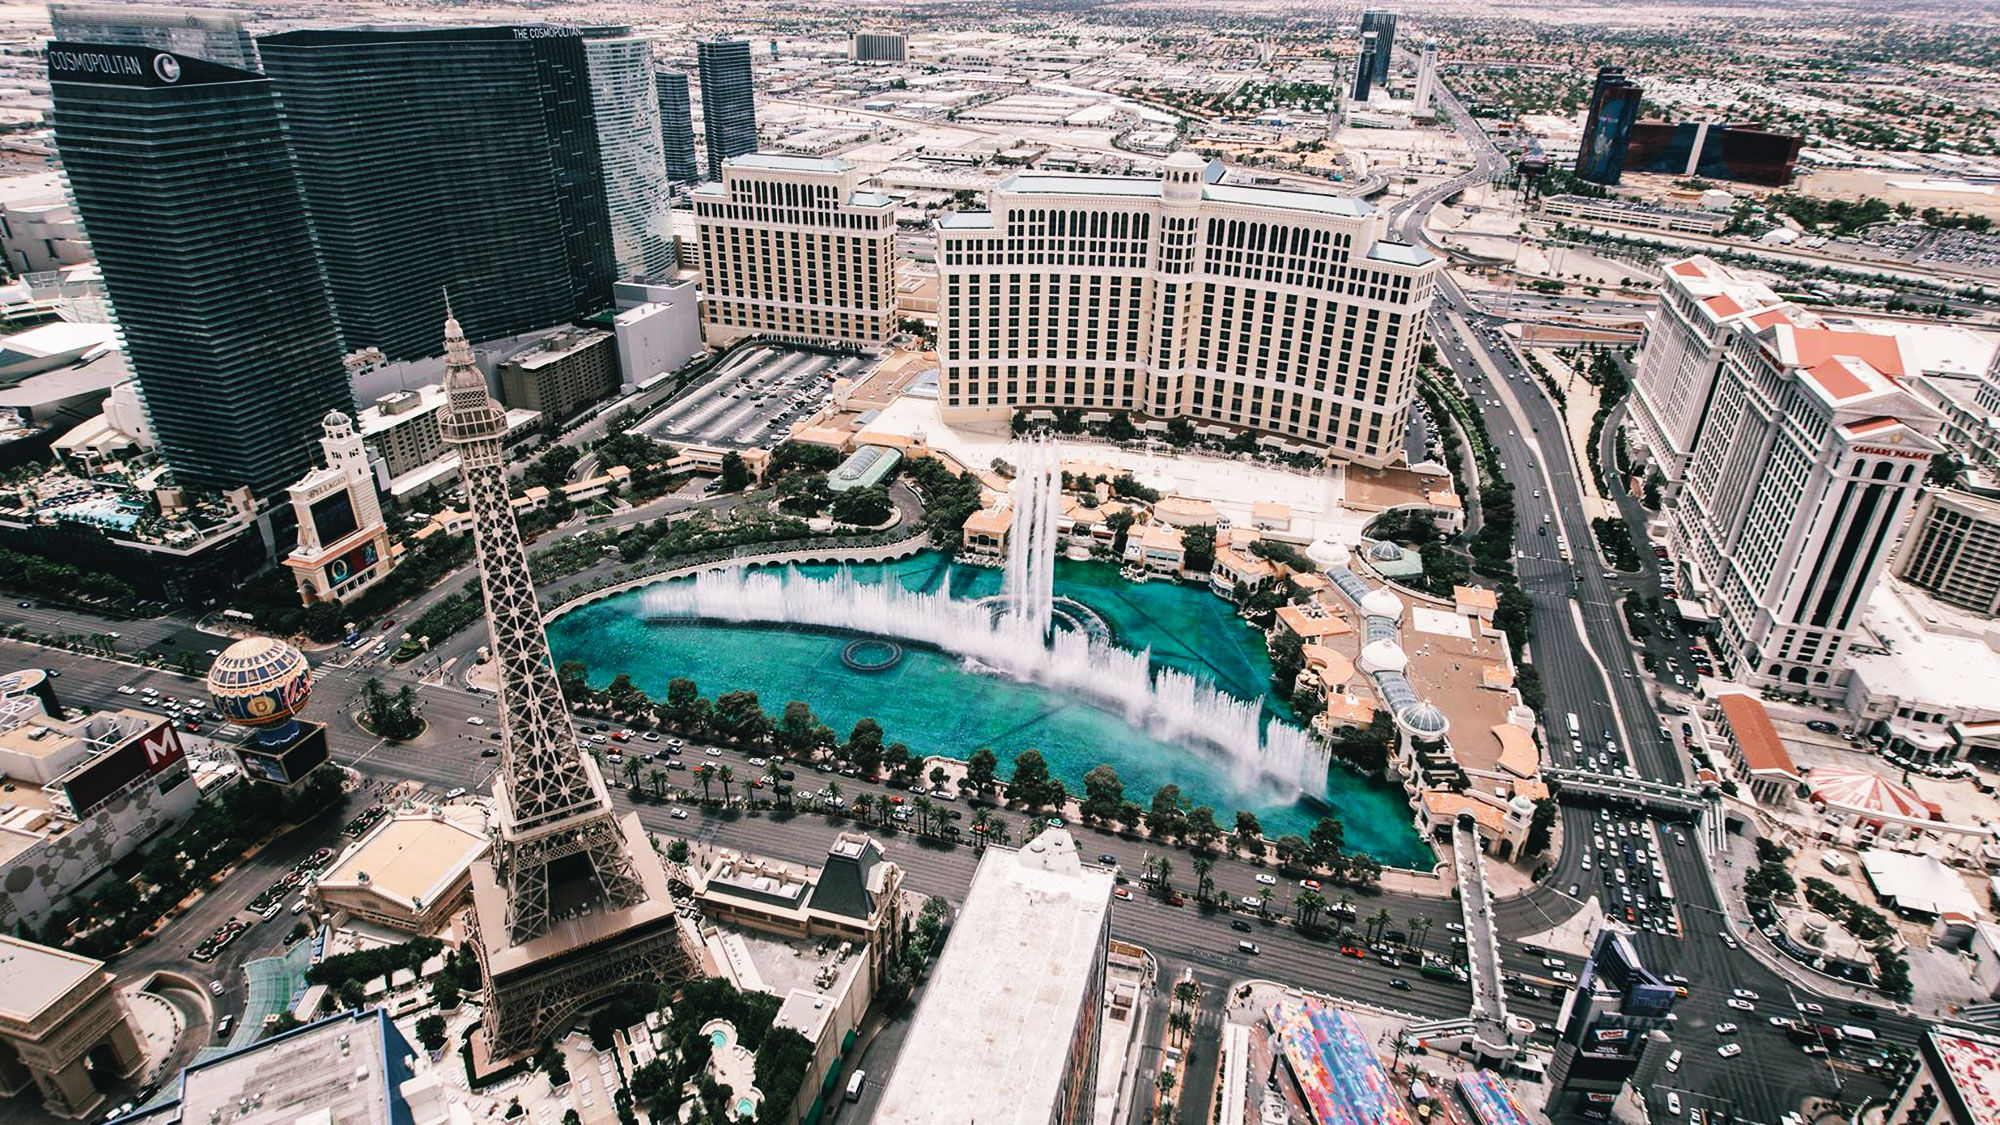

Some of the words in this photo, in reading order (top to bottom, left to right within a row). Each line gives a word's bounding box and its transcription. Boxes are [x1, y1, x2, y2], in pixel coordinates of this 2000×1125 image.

[513, 28, 529, 39] THE
[530, 26, 582, 39] COSMOPOLITAN
[49, 51, 143, 75] COSMOPOLITAN
[144, 726, 178, 765] M
